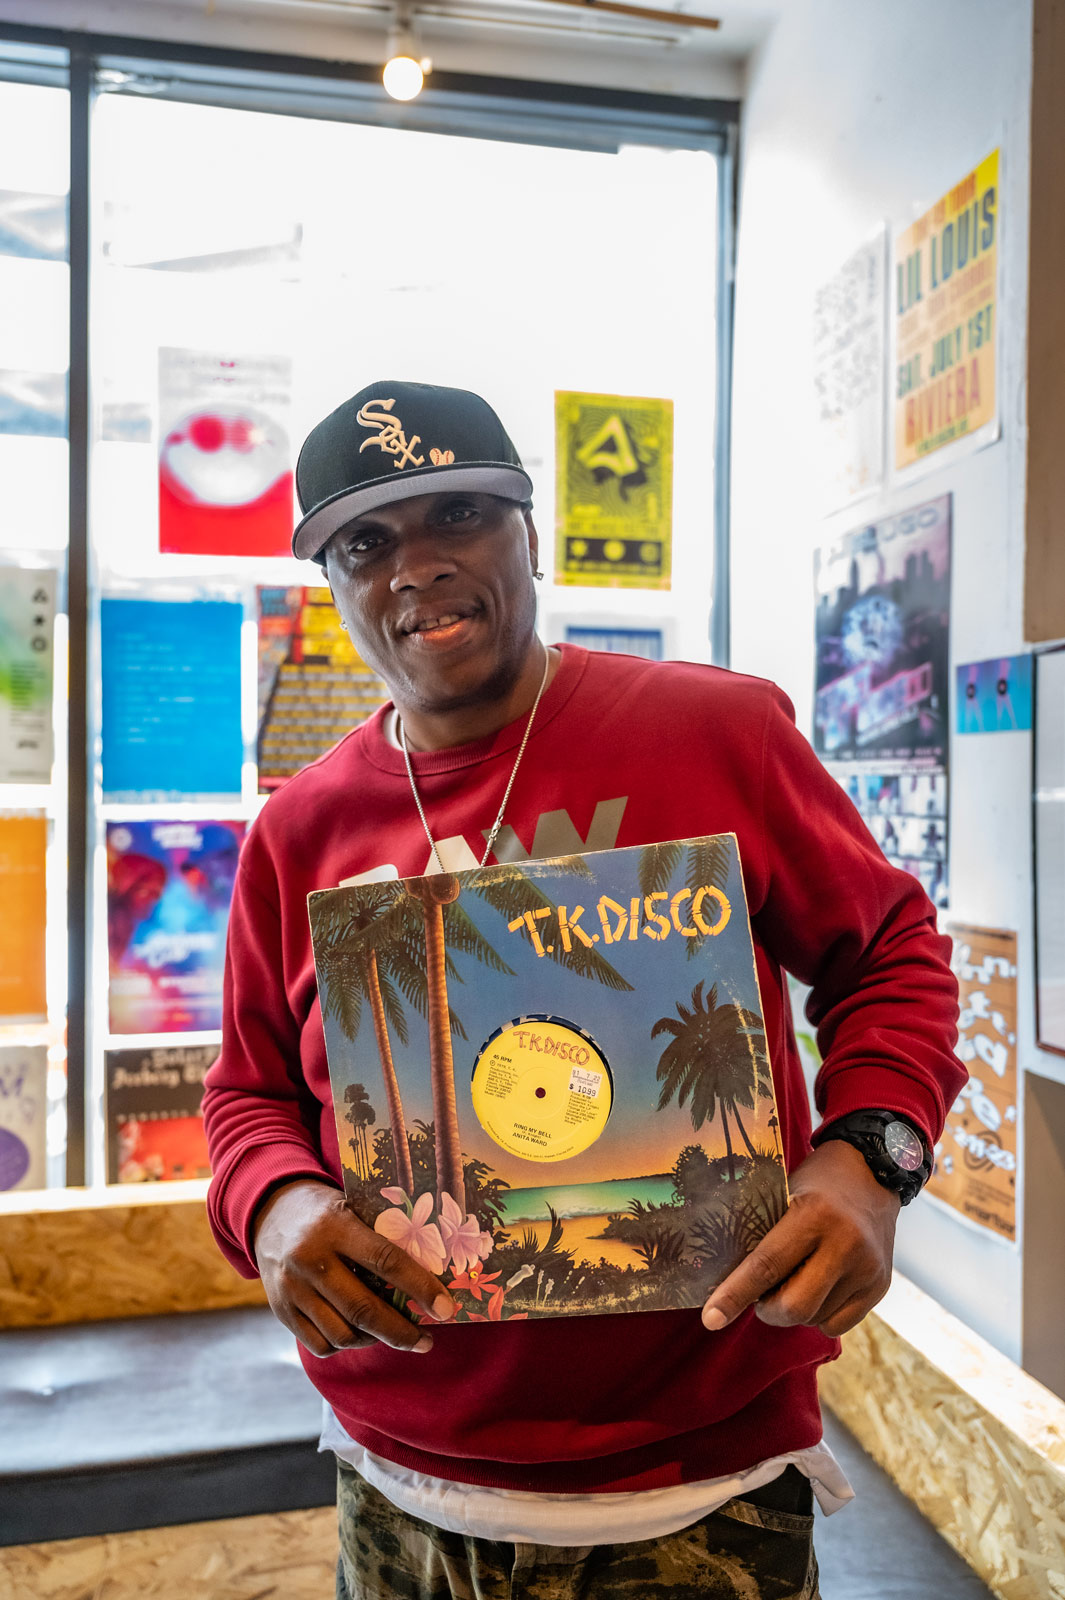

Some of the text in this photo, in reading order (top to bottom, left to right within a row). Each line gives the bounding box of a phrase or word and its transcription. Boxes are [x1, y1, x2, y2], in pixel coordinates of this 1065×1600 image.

[897, 250, 921, 316] LIL
[931, 186, 996, 290] LOUIS
[930, 325, 962, 377] JULY
[967, 303, 993, 353] 1ST
[905, 356, 980, 447] RIVIERA
[500, 1056, 513, 1064] RPM
[512, 1132, 530, 1142] ANITA
[530, 1137, 548, 1148] WARD
[514, 1122, 552, 1139] RING MY BELL
